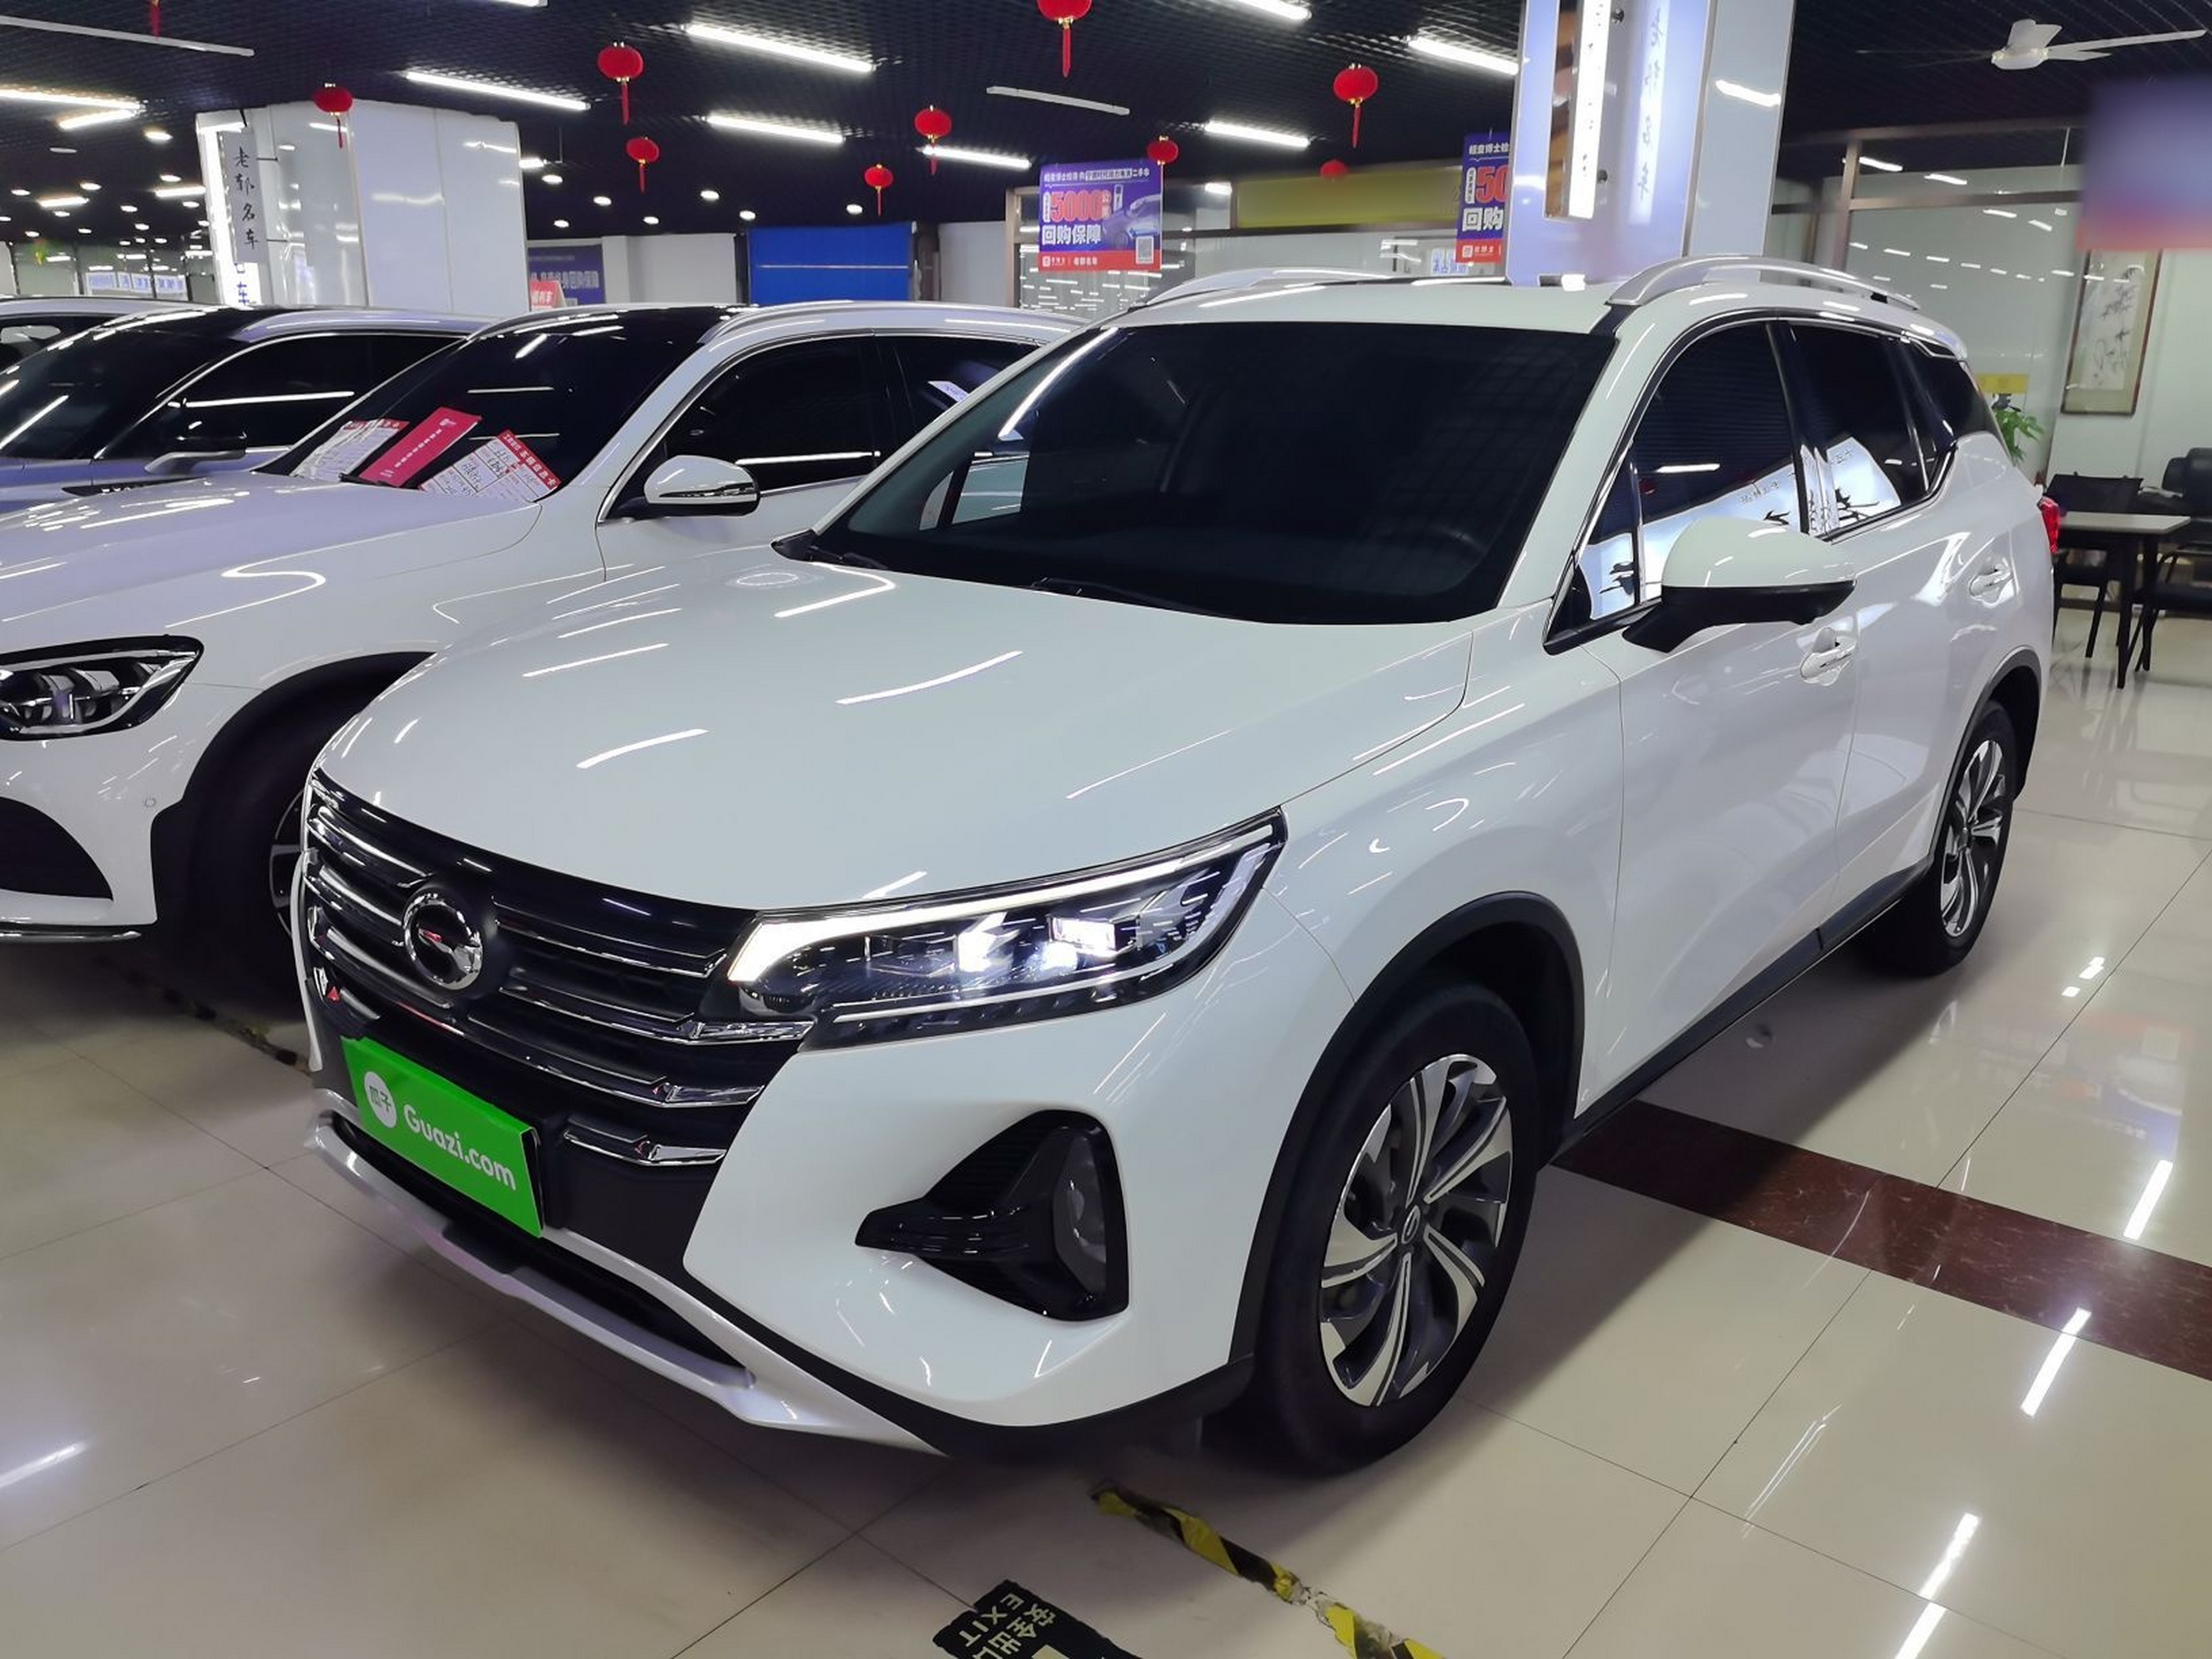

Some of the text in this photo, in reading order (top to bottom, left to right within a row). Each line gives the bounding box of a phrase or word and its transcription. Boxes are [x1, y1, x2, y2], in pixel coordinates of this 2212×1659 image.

[1041, 224, 1101, 246] 回购保障
[1462, 206, 1504, 232] 回购
[402, 1103, 518, 1191] Guazi.com
[959, 1593, 1025, 1647] EXIT
